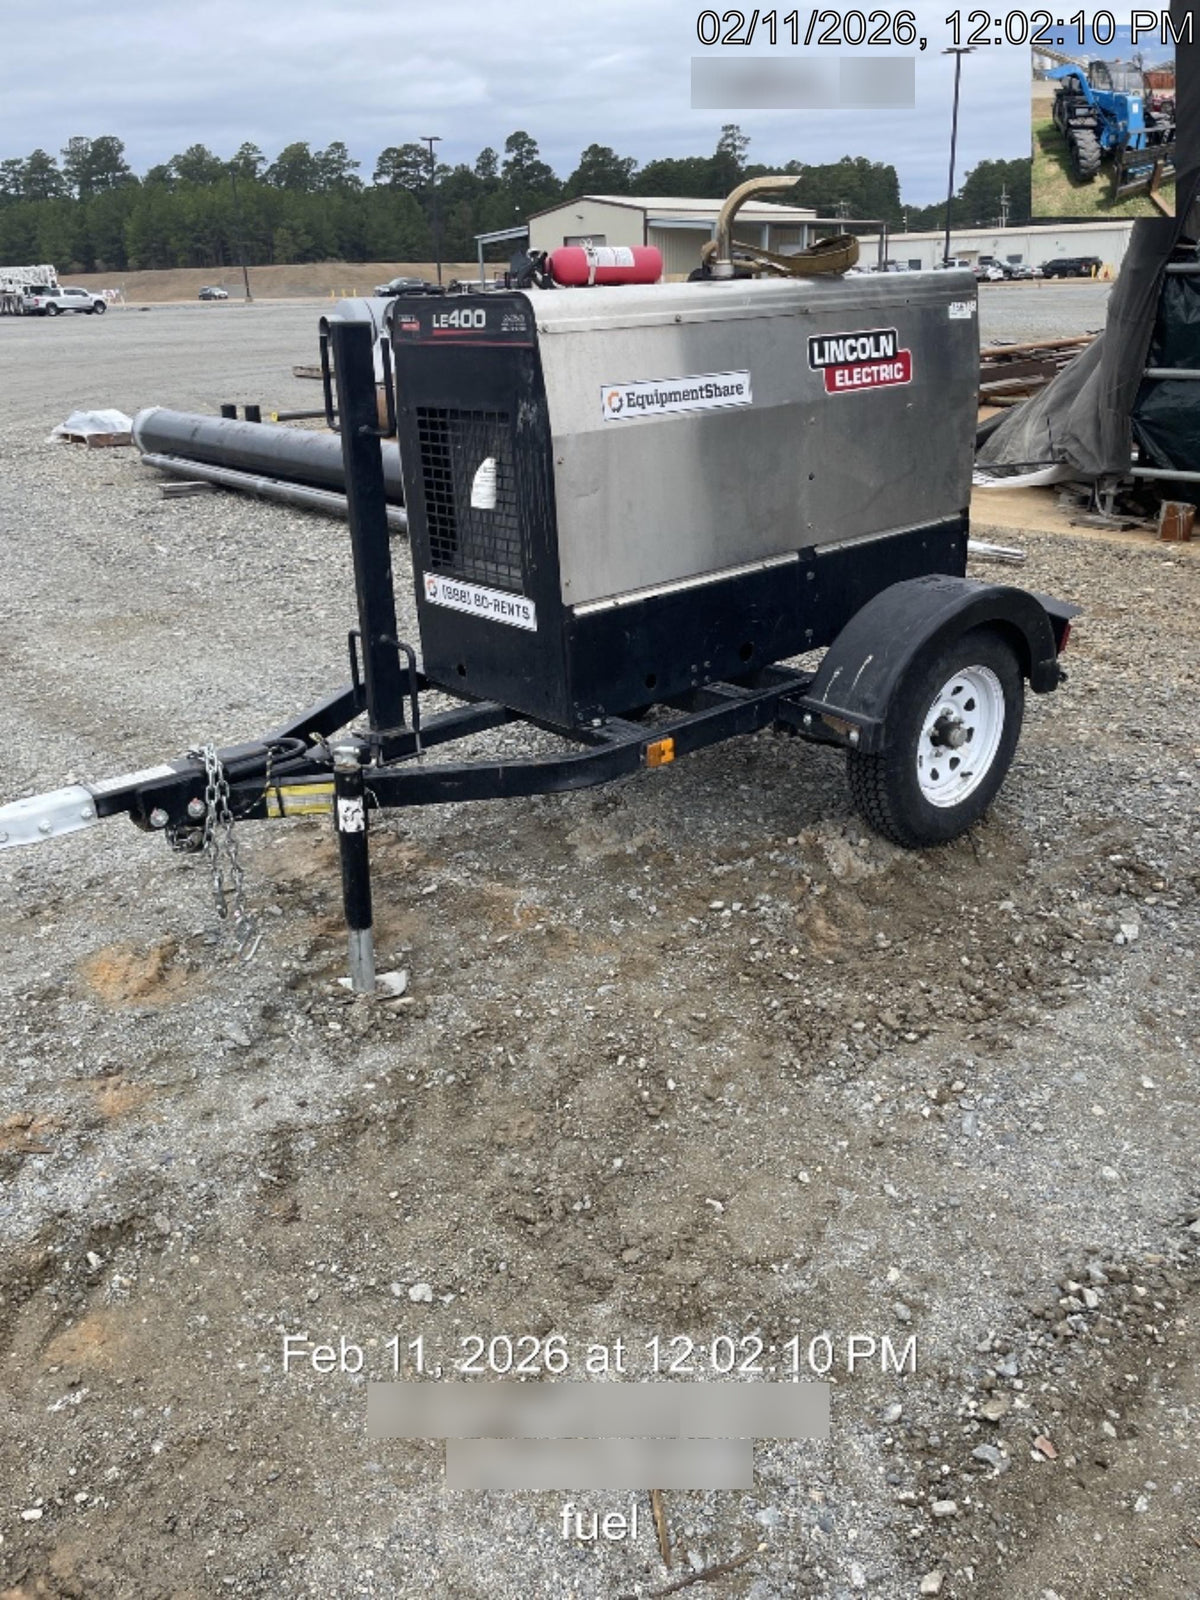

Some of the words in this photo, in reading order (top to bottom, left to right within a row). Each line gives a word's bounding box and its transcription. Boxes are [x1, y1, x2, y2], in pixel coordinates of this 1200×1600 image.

[432, 308, 486, 328] LE400
[813, 333, 894, 365] LINCOLN
[835, 362, 904, 387] ELECTRIC
[625, 382, 744, 409] EquipmentShare
